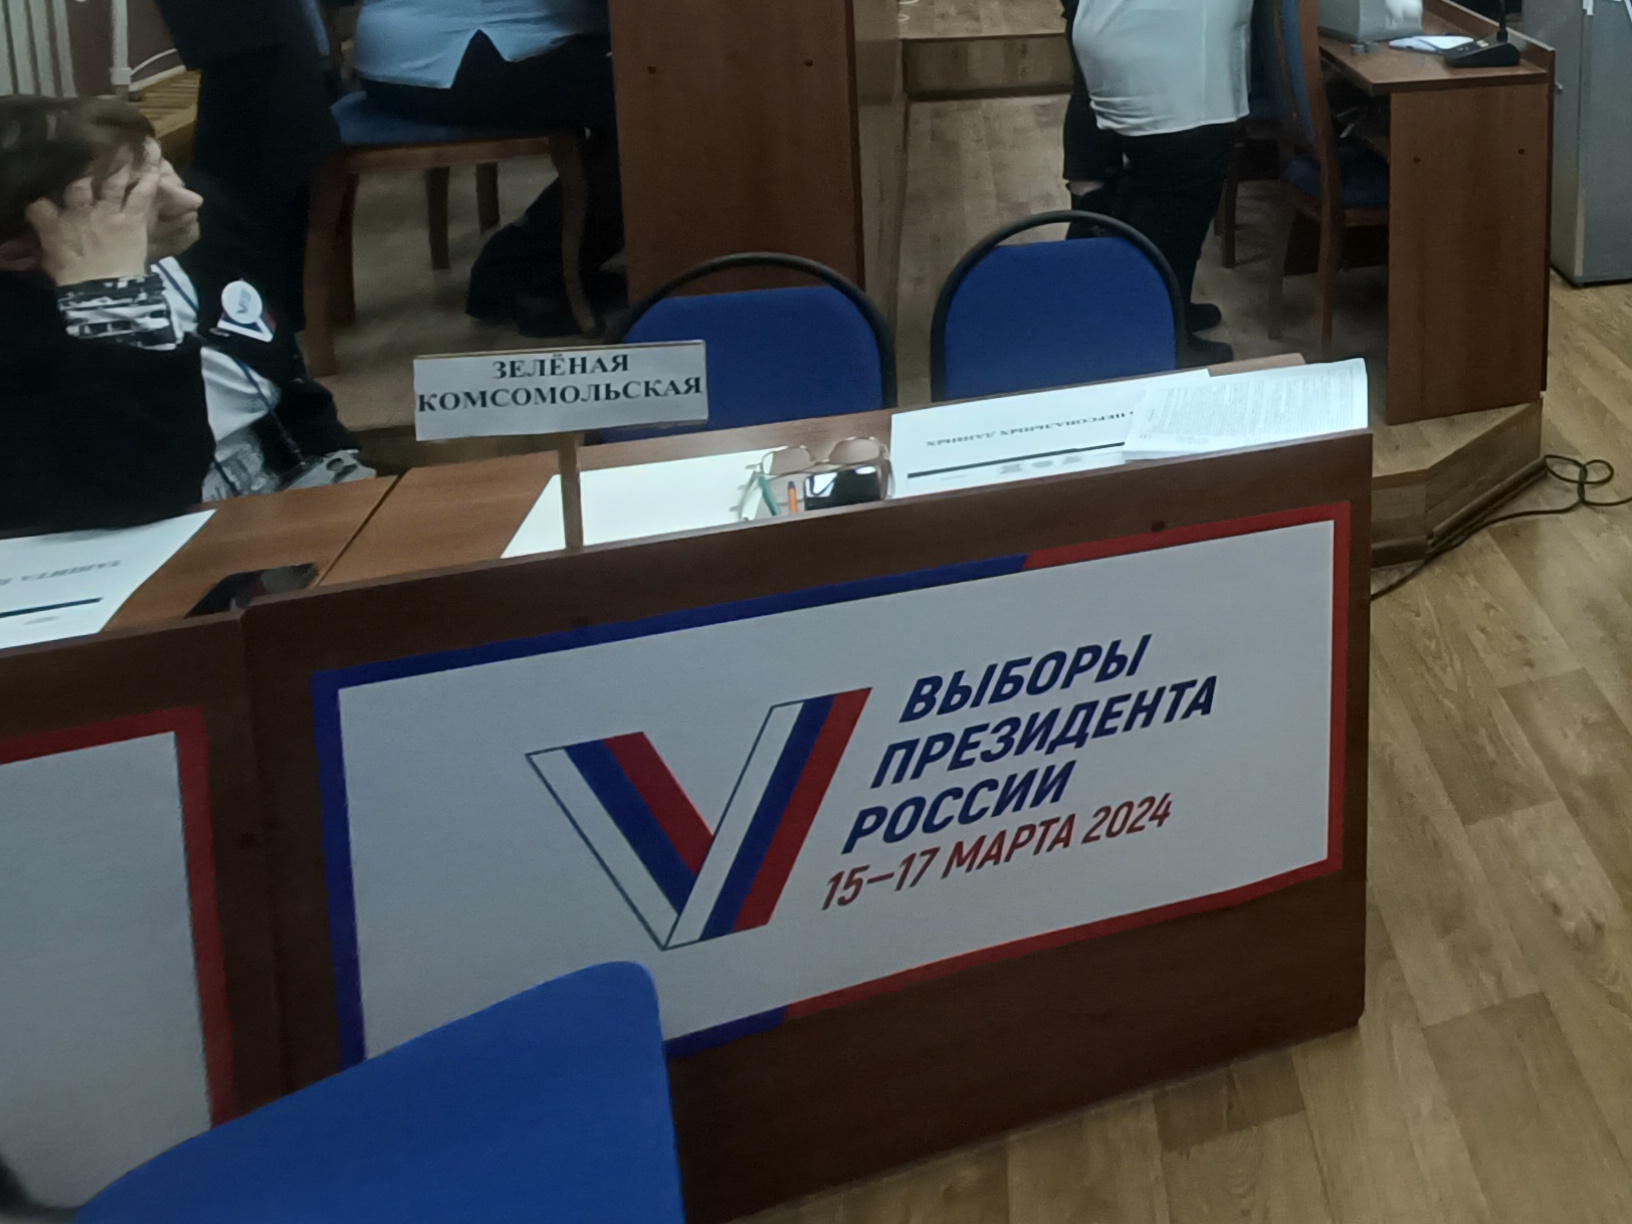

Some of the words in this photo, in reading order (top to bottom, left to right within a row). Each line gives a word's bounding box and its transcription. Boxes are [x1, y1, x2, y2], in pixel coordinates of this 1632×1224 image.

[416, 376, 702, 413] КОМСОМОЛЬСКАЯ
[492, 352, 630, 380] ЗЕЛЁНАЯ
[898, 633, 1153, 723] ВЫБОРЫ
[870, 675, 1218, 789] ПРЕЗИДЕНТА
[841, 759, 1077, 855] РОССИИ
[940, 814, 1075, 880] МАРТА
[1081, 792, 1173, 845] 2024
